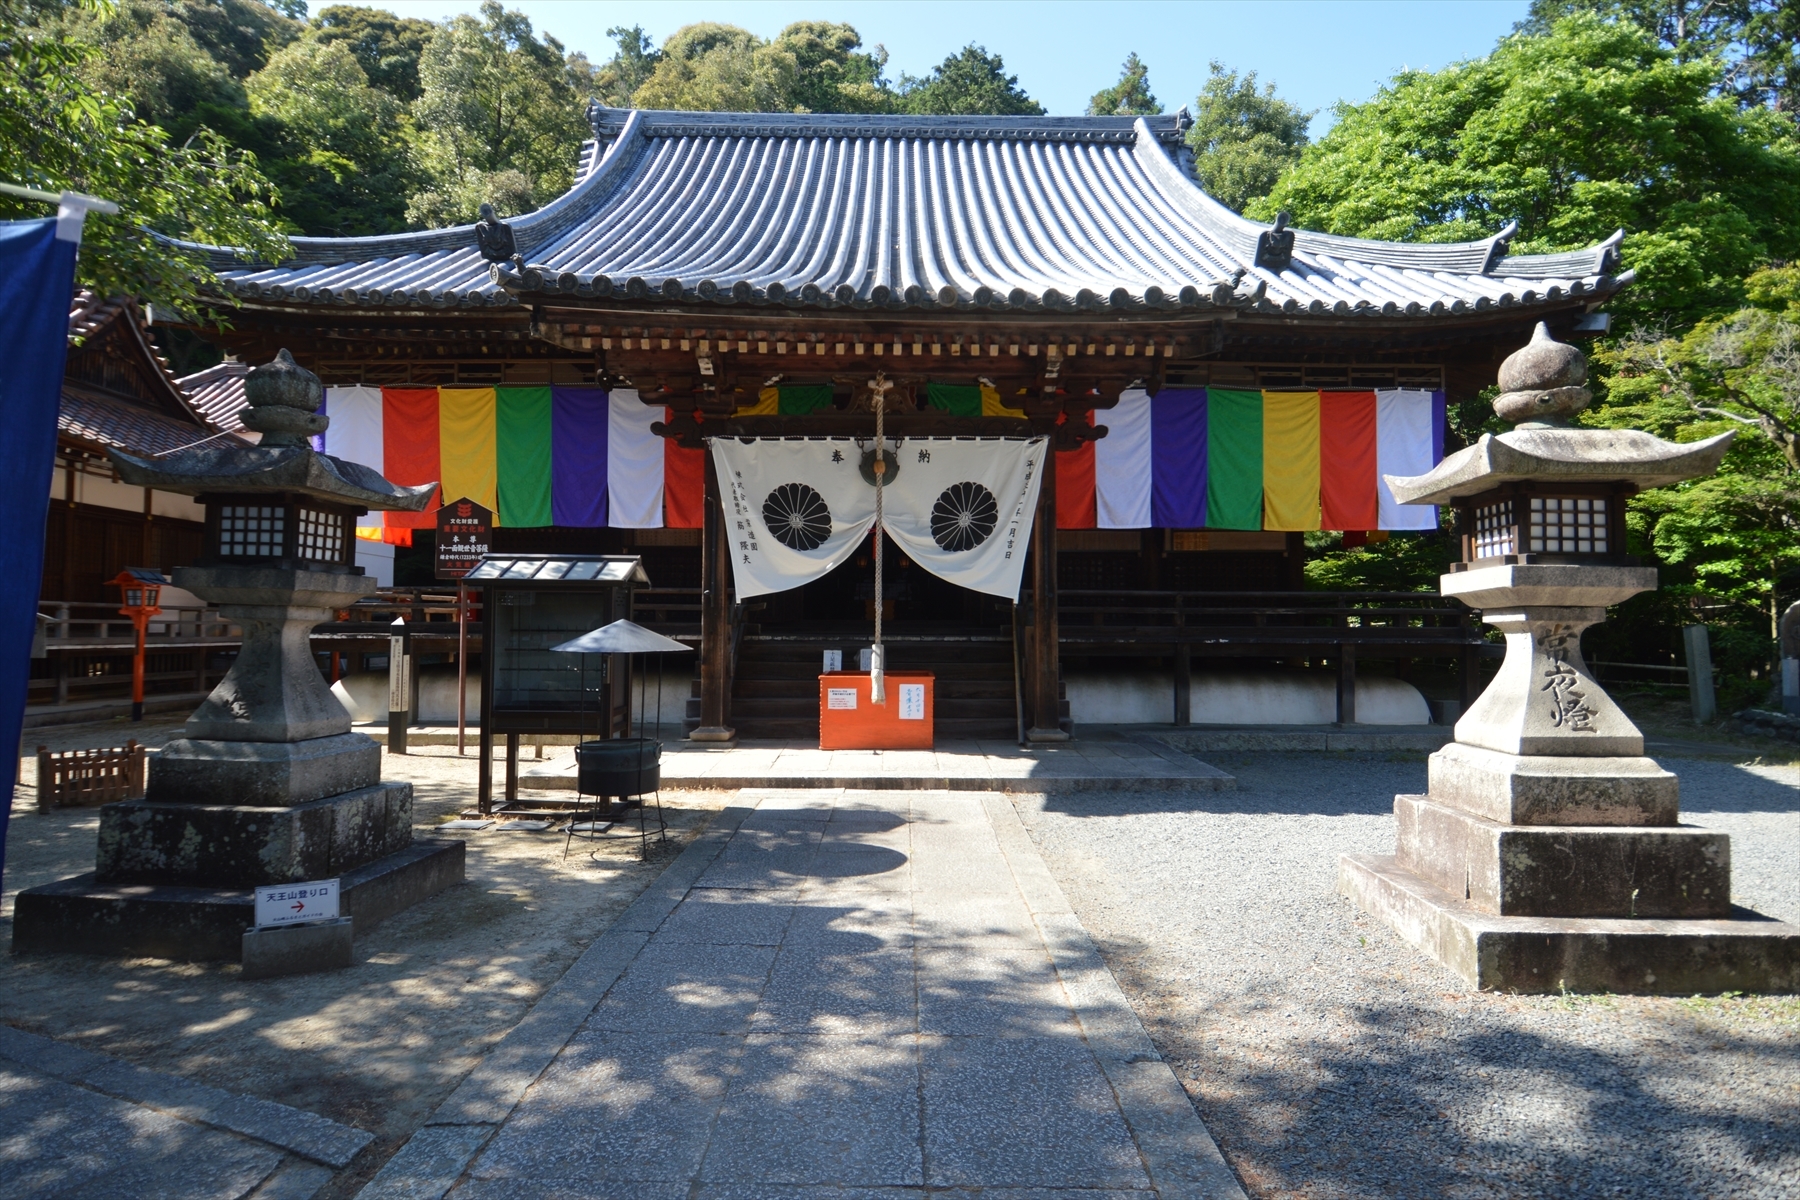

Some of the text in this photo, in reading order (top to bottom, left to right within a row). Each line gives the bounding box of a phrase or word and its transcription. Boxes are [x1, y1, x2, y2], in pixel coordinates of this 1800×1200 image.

[832, 449, 930, 464] 奉 納
[443, 525, 485, 533] 重要文化財
[1537, 623, 1599, 734] 常夜燈
[266, 888, 328, 902] 天王山登り口
